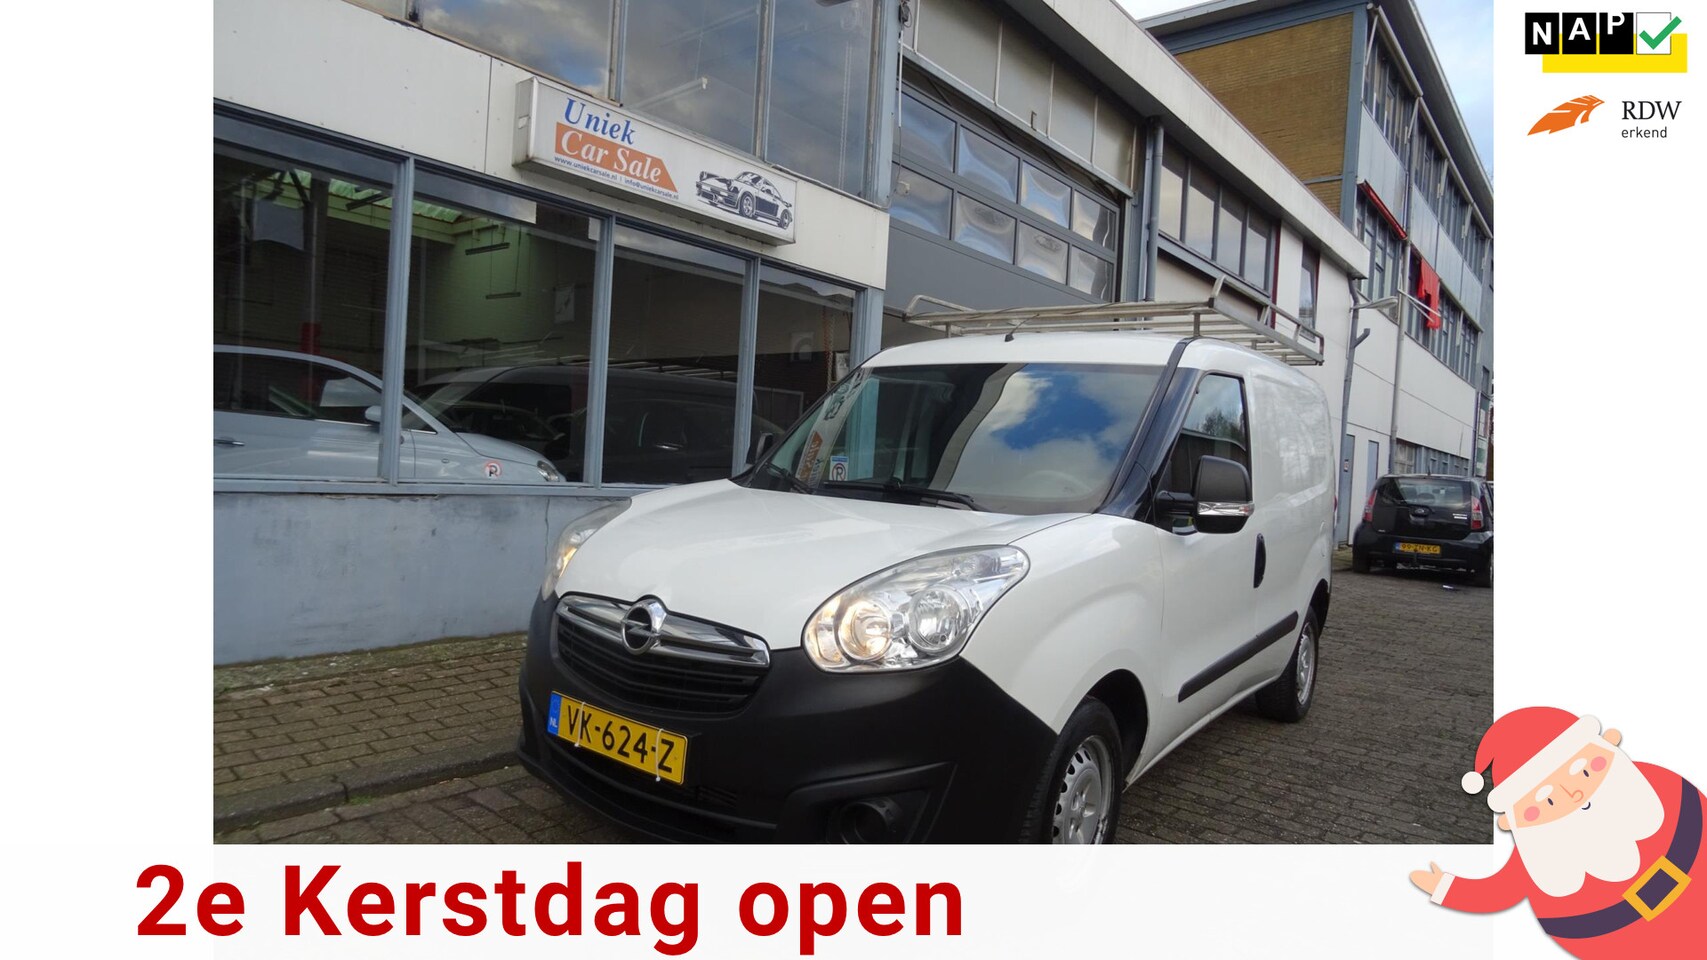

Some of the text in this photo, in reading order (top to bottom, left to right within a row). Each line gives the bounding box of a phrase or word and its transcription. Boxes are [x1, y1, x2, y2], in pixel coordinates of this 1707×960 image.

[564, 97, 636, 146] Uniek
[554, 155, 680, 201] www.uniekcarsale.nl info@uniekcarsale.nl
[560, 129, 662, 184] Car Sale
[549, 716, 559, 728] NL
[567, 704, 676, 774] VK-624-Z
